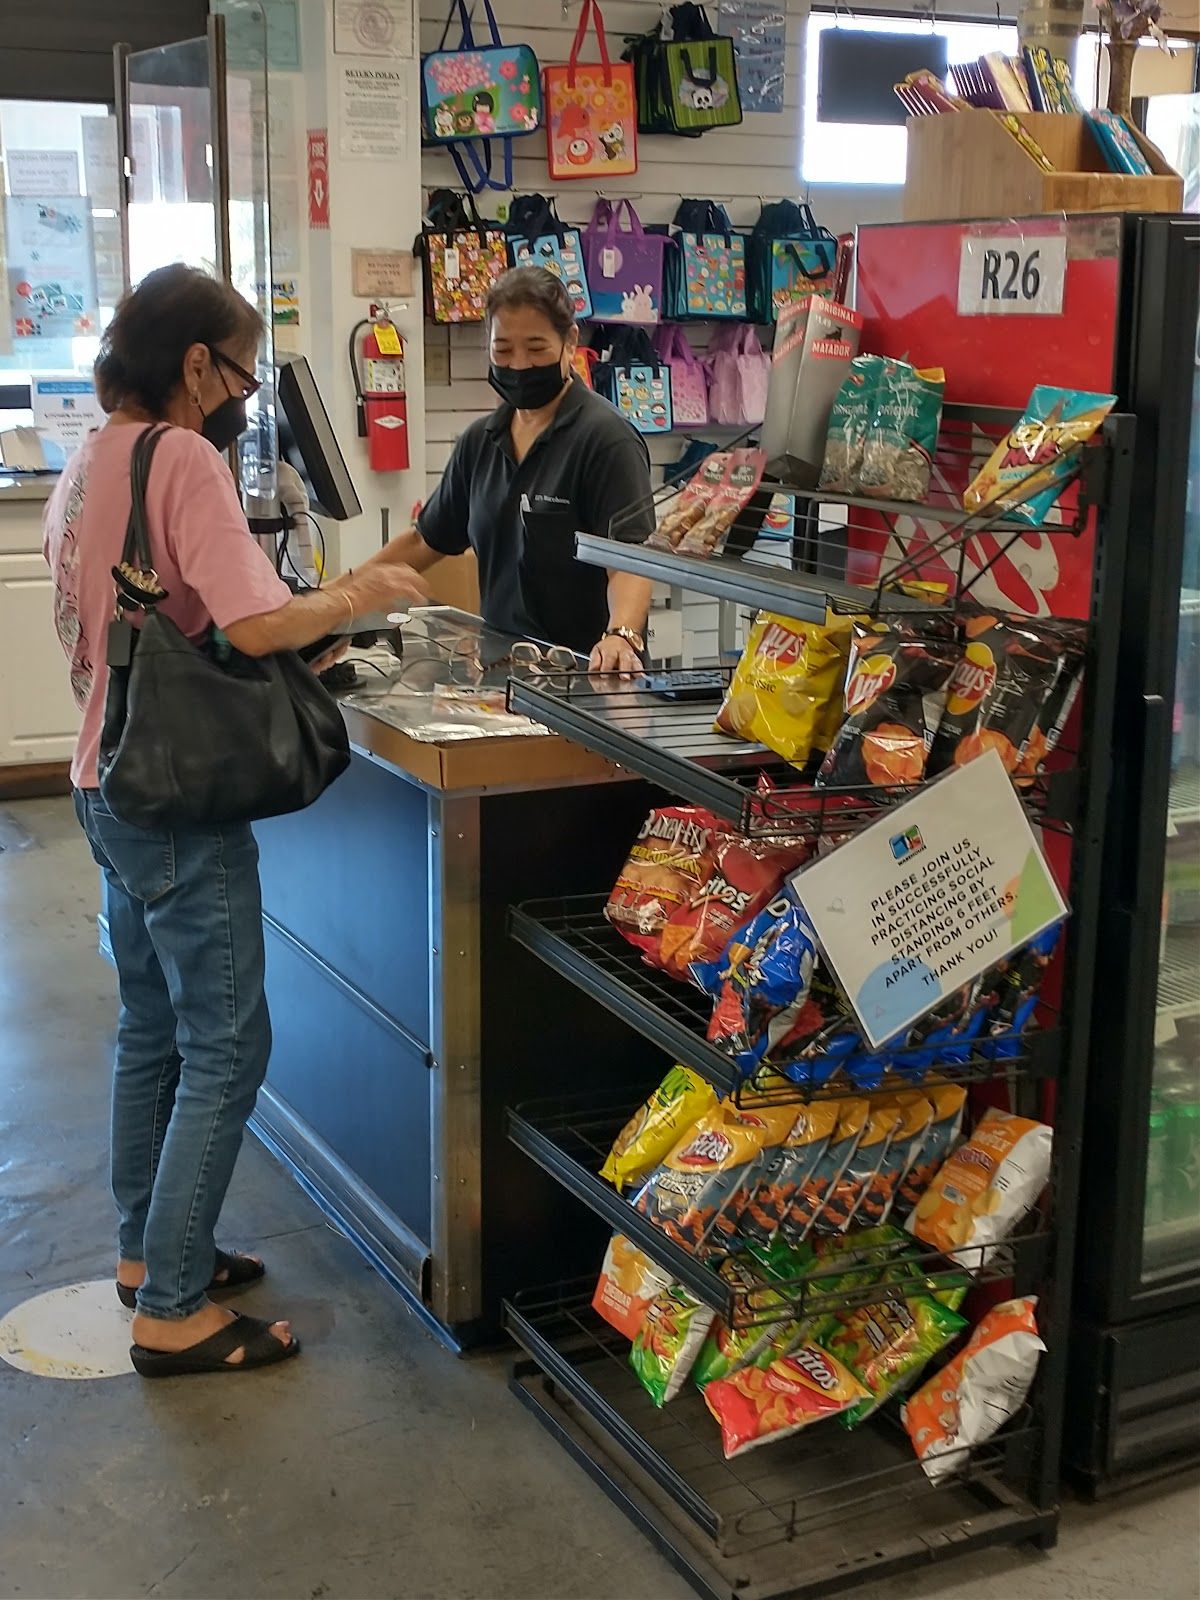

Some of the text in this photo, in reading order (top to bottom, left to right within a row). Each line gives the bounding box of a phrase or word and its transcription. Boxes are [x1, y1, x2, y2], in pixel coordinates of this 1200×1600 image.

[311, 143, 325, 158] FIRE
[981, 249, 1040, 300] R26
[819, 301, 855, 324] ORIGINAL
[812, 341, 850, 357] MATADOR
[870, 838, 971, 912] PLEASE JOIN US
[870, 856, 995, 946] PRACTICING SOCIAL
[871, 846, 980, 929] IN SUCCESSFULLY
[885, 891, 1019, 989] APART FROM OTHERS.
[890, 876, 985, 949] DISTANCING BY
[891, 885, 996, 966] STANDING 6 FEET
[921, 928, 998, 986] THANK YOU!
[786, 1345, 839, 1391] ritos
